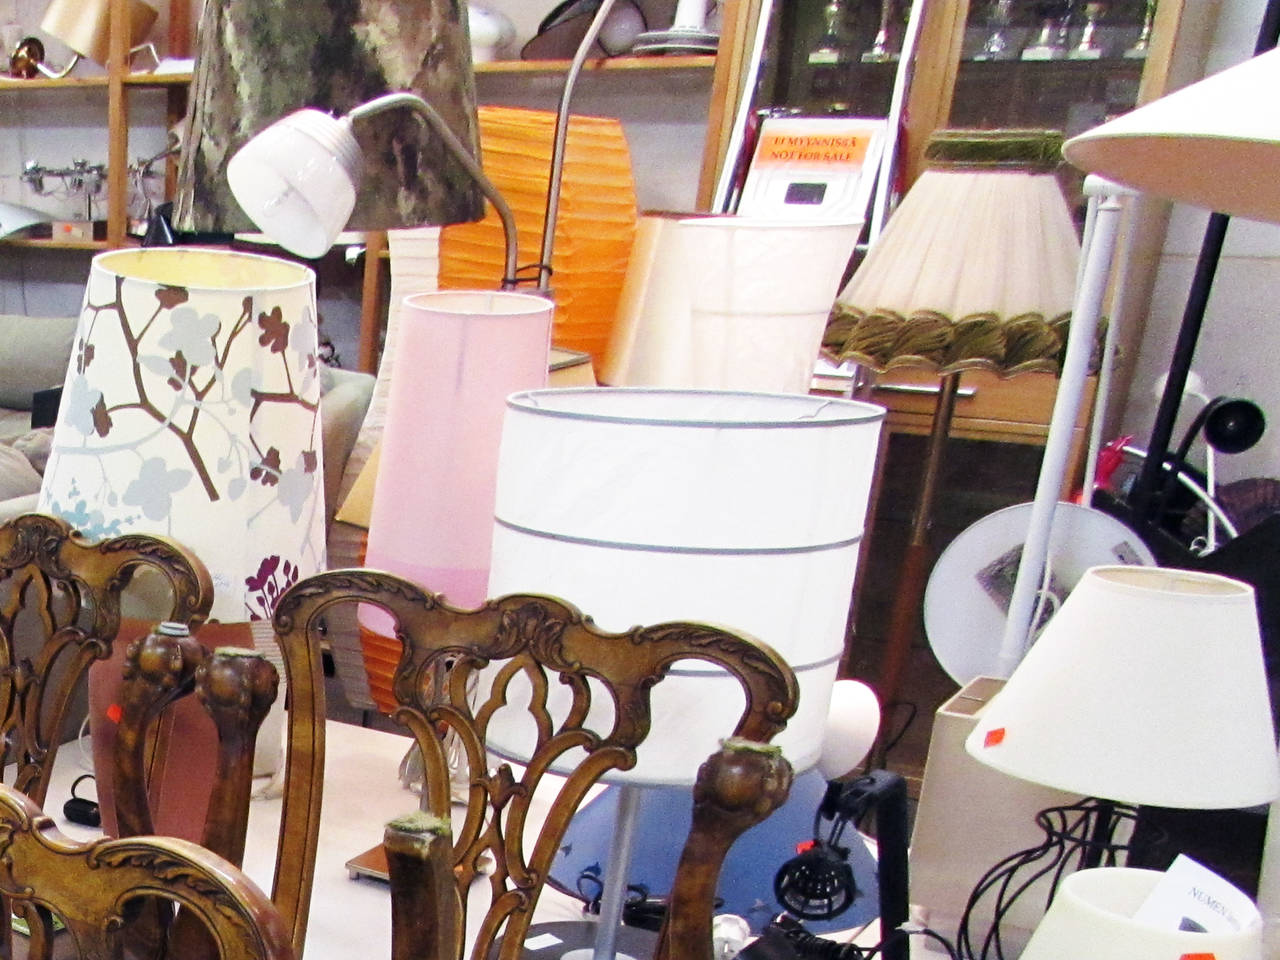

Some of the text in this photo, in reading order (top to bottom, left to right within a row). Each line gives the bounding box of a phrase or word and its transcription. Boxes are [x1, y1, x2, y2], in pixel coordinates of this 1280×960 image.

[769, 151, 853, 162] NOT FOR SALE
